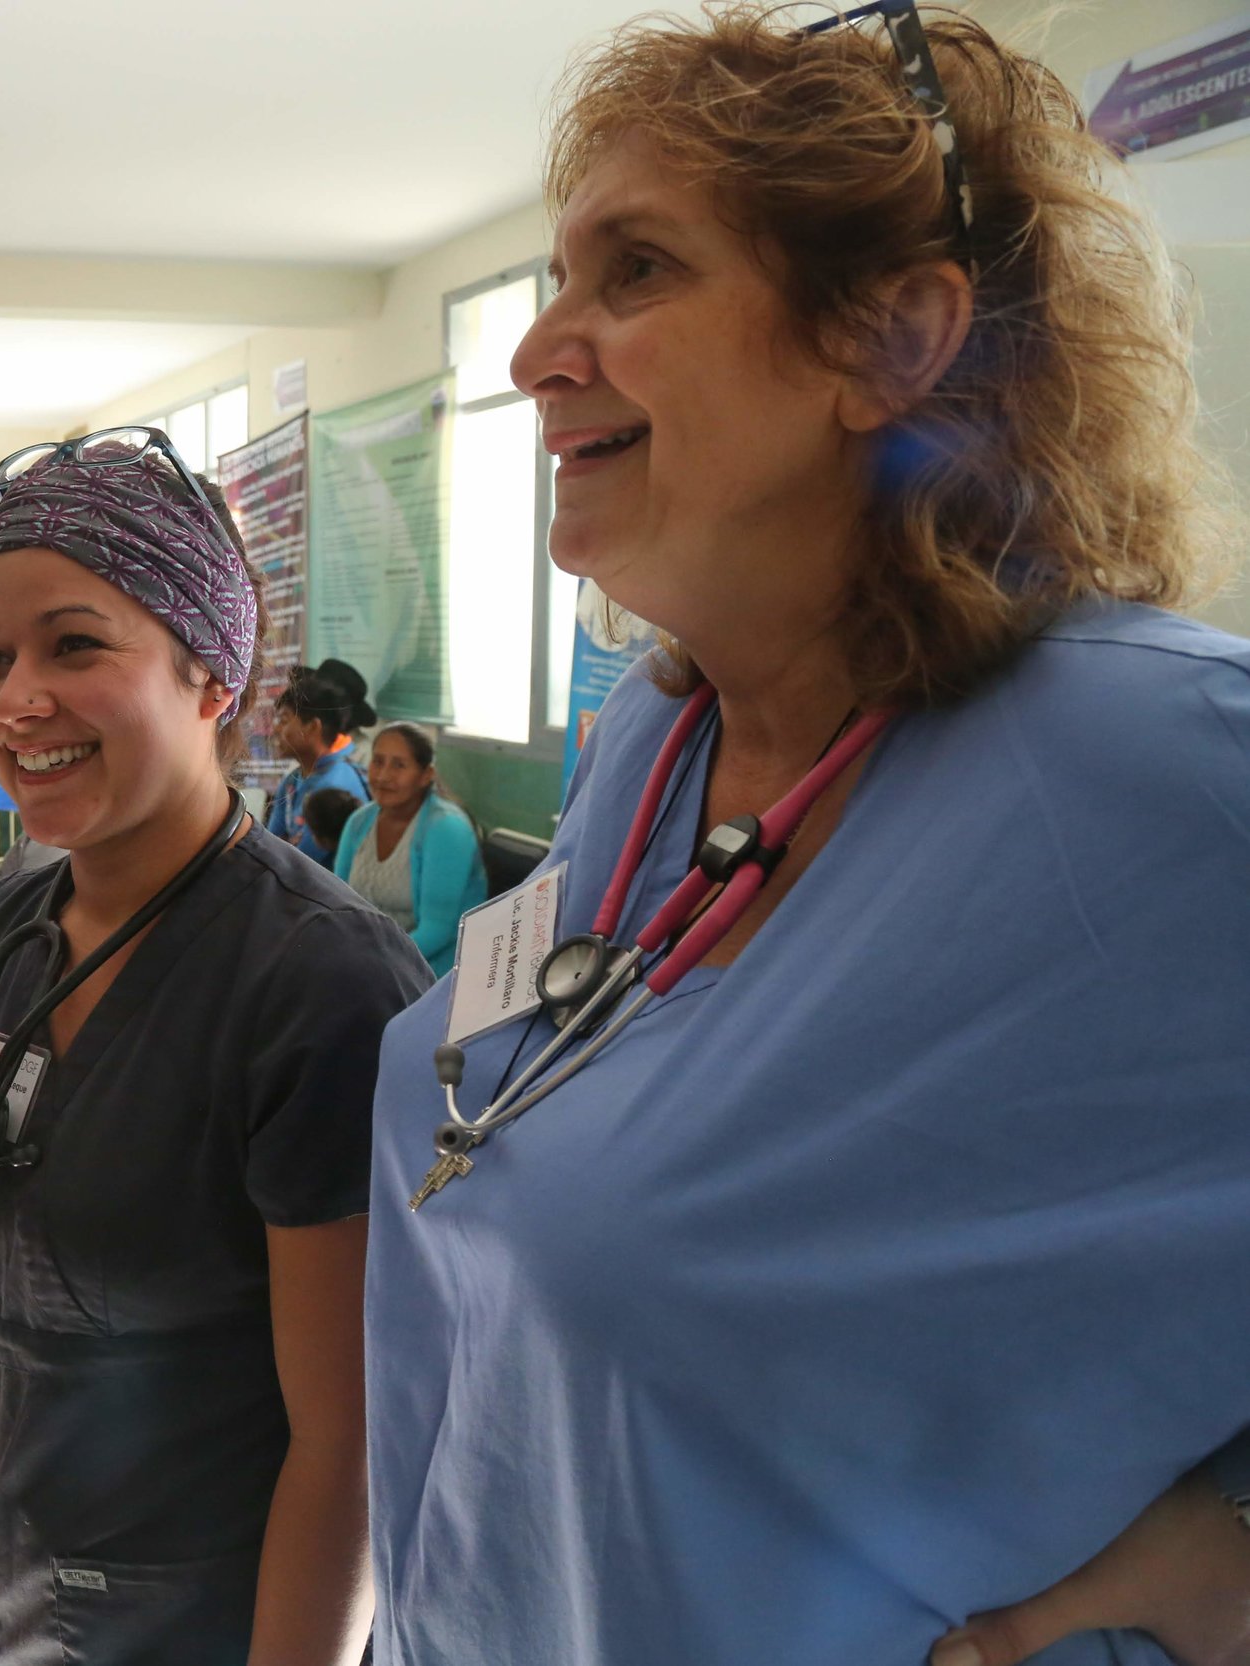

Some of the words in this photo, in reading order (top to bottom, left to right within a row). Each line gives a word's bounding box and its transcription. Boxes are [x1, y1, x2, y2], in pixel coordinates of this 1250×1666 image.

[487, 934, 503, 989] Enfermera
[508, 919, 524, 953] Jackie
[501, 953, 519, 1009] Mortillaro
